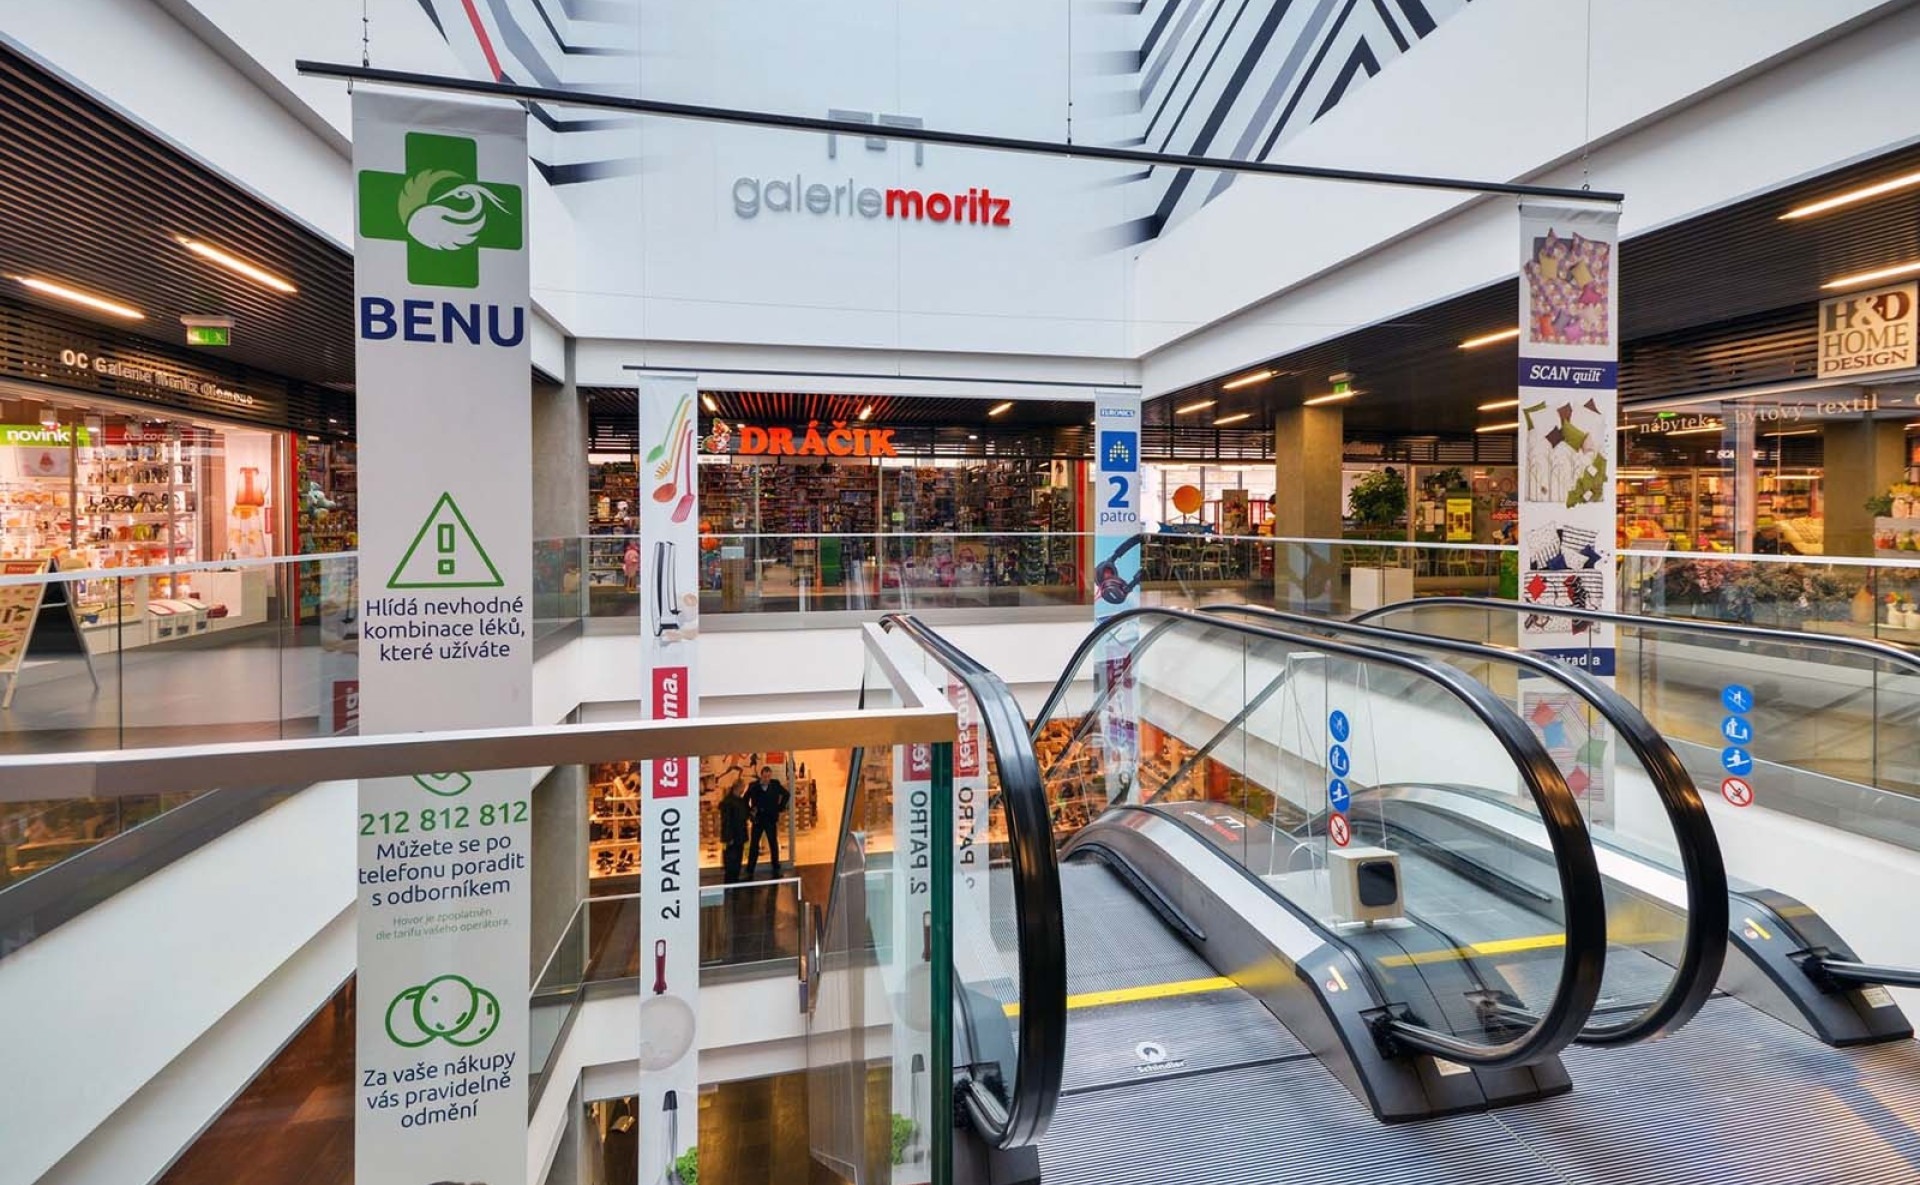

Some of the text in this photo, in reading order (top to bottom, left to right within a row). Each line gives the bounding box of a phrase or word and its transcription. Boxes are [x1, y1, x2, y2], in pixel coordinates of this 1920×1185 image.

[361, 297, 524, 347] BENU
[1824, 291, 1910, 333] H&D
[1823, 322, 1909, 357] HOME
[62, 350, 88, 369] OC
[1530, 365, 1601, 384] SCAN quilt
[1823, 349, 1908, 372] DESIGN
[1640, 413, 1709, 434] nábytek
[1735, 402, 1805, 424] bytový
[1816, 393, 1878, 416] textil
[739, 420, 898, 457] DRÁČIK
[1107, 475, 1130, 509] 2
[1100, 511, 1137, 525] patro
[366, 595, 523, 616] Hlídá nevhodné
[364, 617, 525, 639] kombinace léků,
[380, 640, 510, 661] které užíváte
[360, 800, 528, 836] 212 812 812
[377, 835, 512, 860] Můžete se po
[358, 852, 525, 885] telefonu poradit
[660, 807, 681, 920] 2. PATRO
[371, 879, 510, 907] s odborníkem
[376, 930, 392, 941] dle
[424, 922, 458, 936] vašeho
[393, 914, 423, 926] Hovor
[425, 911, 435, 924] je
[363, 1051, 516, 1087] Za vaše nákupy
[367, 1071, 511, 1110] vás pravidelně
[401, 1098, 479, 1128] odmění
